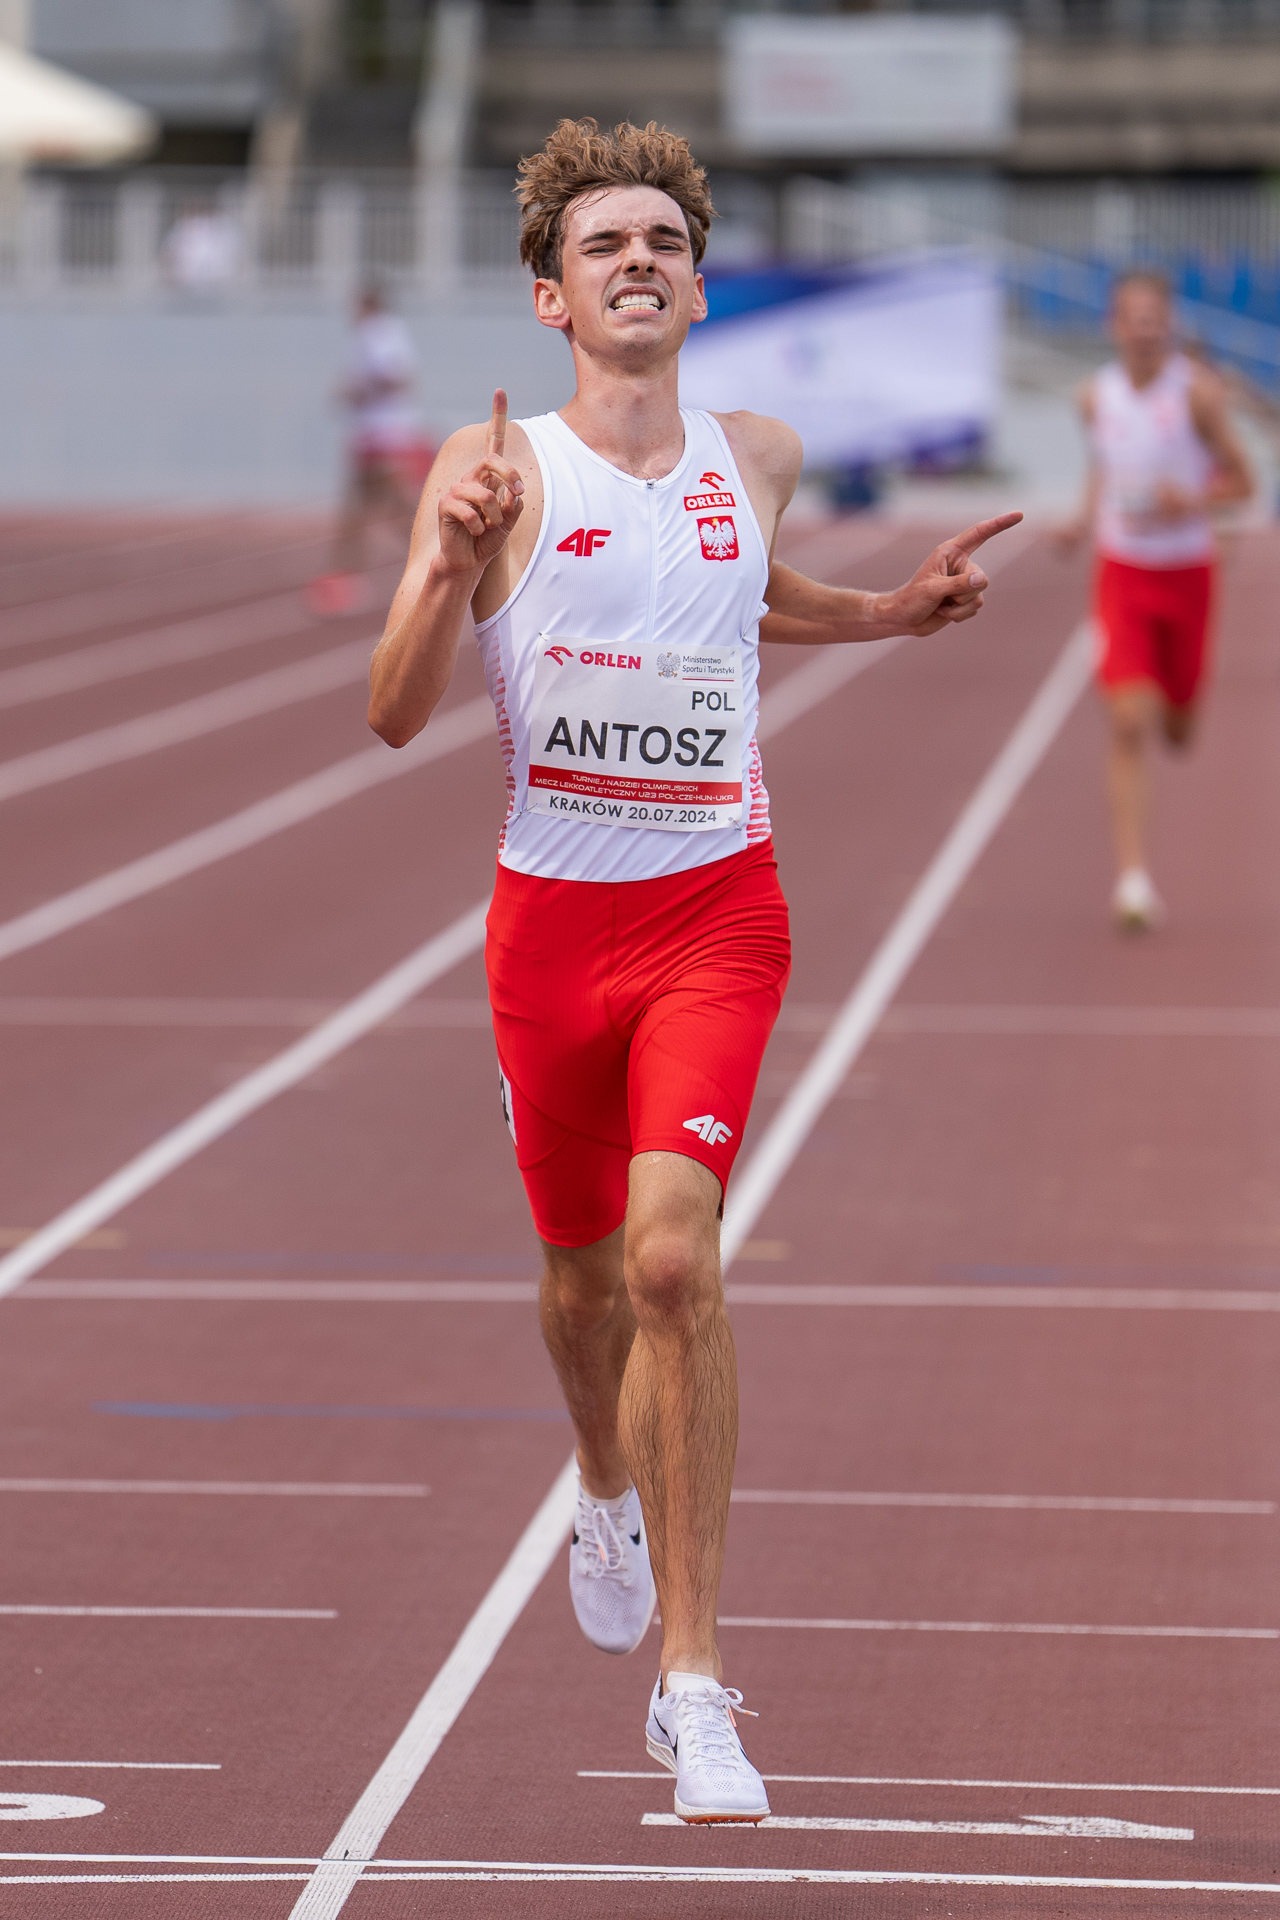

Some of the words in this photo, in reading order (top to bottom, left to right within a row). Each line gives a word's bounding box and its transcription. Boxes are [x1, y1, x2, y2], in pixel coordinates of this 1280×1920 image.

[686, 494, 733, 509] ORLEN
[556, 527, 612, 557] 4F
[579, 651, 642, 670] ORLEN
[682, 655, 722, 664] Ministerstwo
[682, 665, 703, 674] Sportu
[707, 666, 735, 675] Turystyki
[691, 690, 736, 711] POL
[544, 716, 727, 767] ANTOSZ
[534, 777, 559, 786] MECZ
[559, 781, 637, 797] LEKKOATLETYCZNY
[658, 792, 734, 801] POL-CZE-HUN-UKR
[571, 774, 606, 785] TURNIEJ
[606, 780, 640, 789] NADZIEI
[641, 782, 698, 792] OLIMPIJSKICH
[549, 795, 623, 818] KRAKÓW
[628, 806, 717, 823] 20.07.2024
[682, 1114, 733, 1146] 4F
